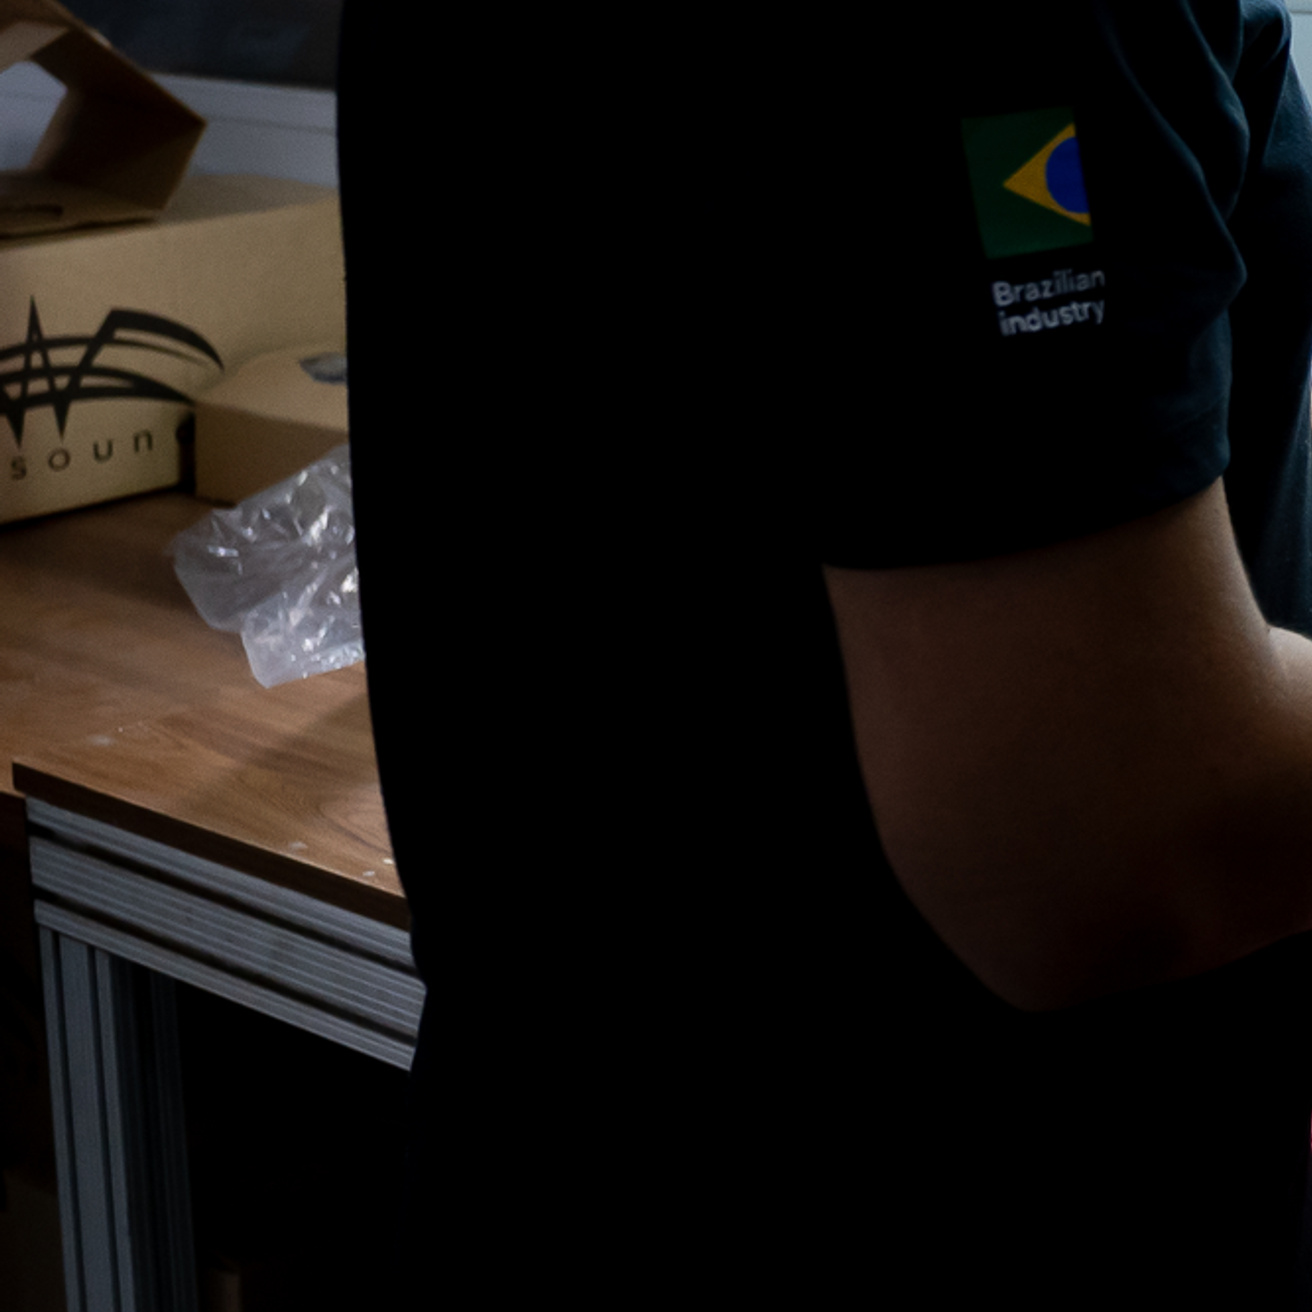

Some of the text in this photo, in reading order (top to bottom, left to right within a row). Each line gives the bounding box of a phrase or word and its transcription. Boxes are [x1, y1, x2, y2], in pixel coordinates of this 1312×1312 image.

[991, 269, 1106, 307] Brazilian
[997, 300, 1106, 336] industry
[10, 428, 154, 481] soun
